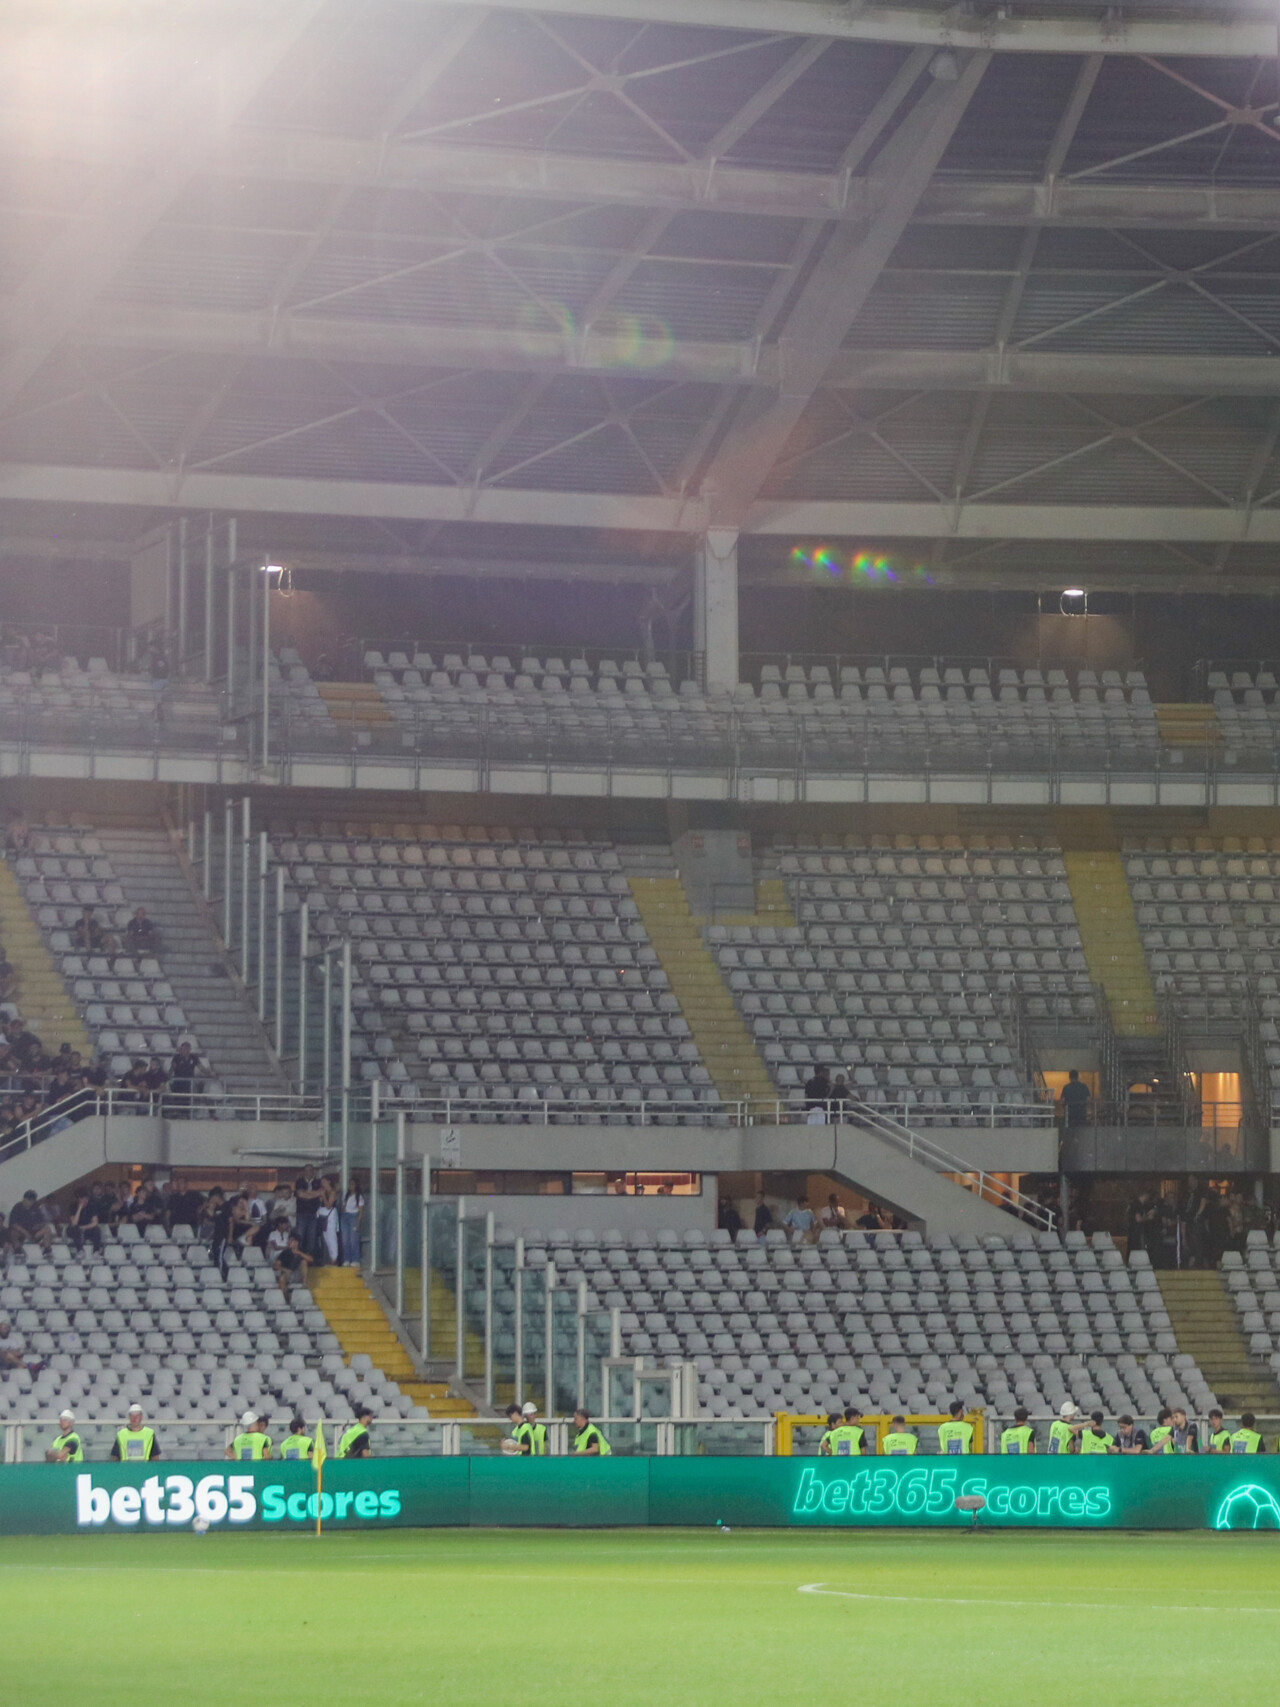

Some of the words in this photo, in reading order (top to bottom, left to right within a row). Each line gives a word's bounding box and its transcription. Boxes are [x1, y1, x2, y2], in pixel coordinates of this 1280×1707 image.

[77, 1474, 257, 1527] bet365
[262, 1485, 401, 1519] Scores
[794, 1468, 957, 1515] bet365
[959, 1477, 1111, 1517] Scores
